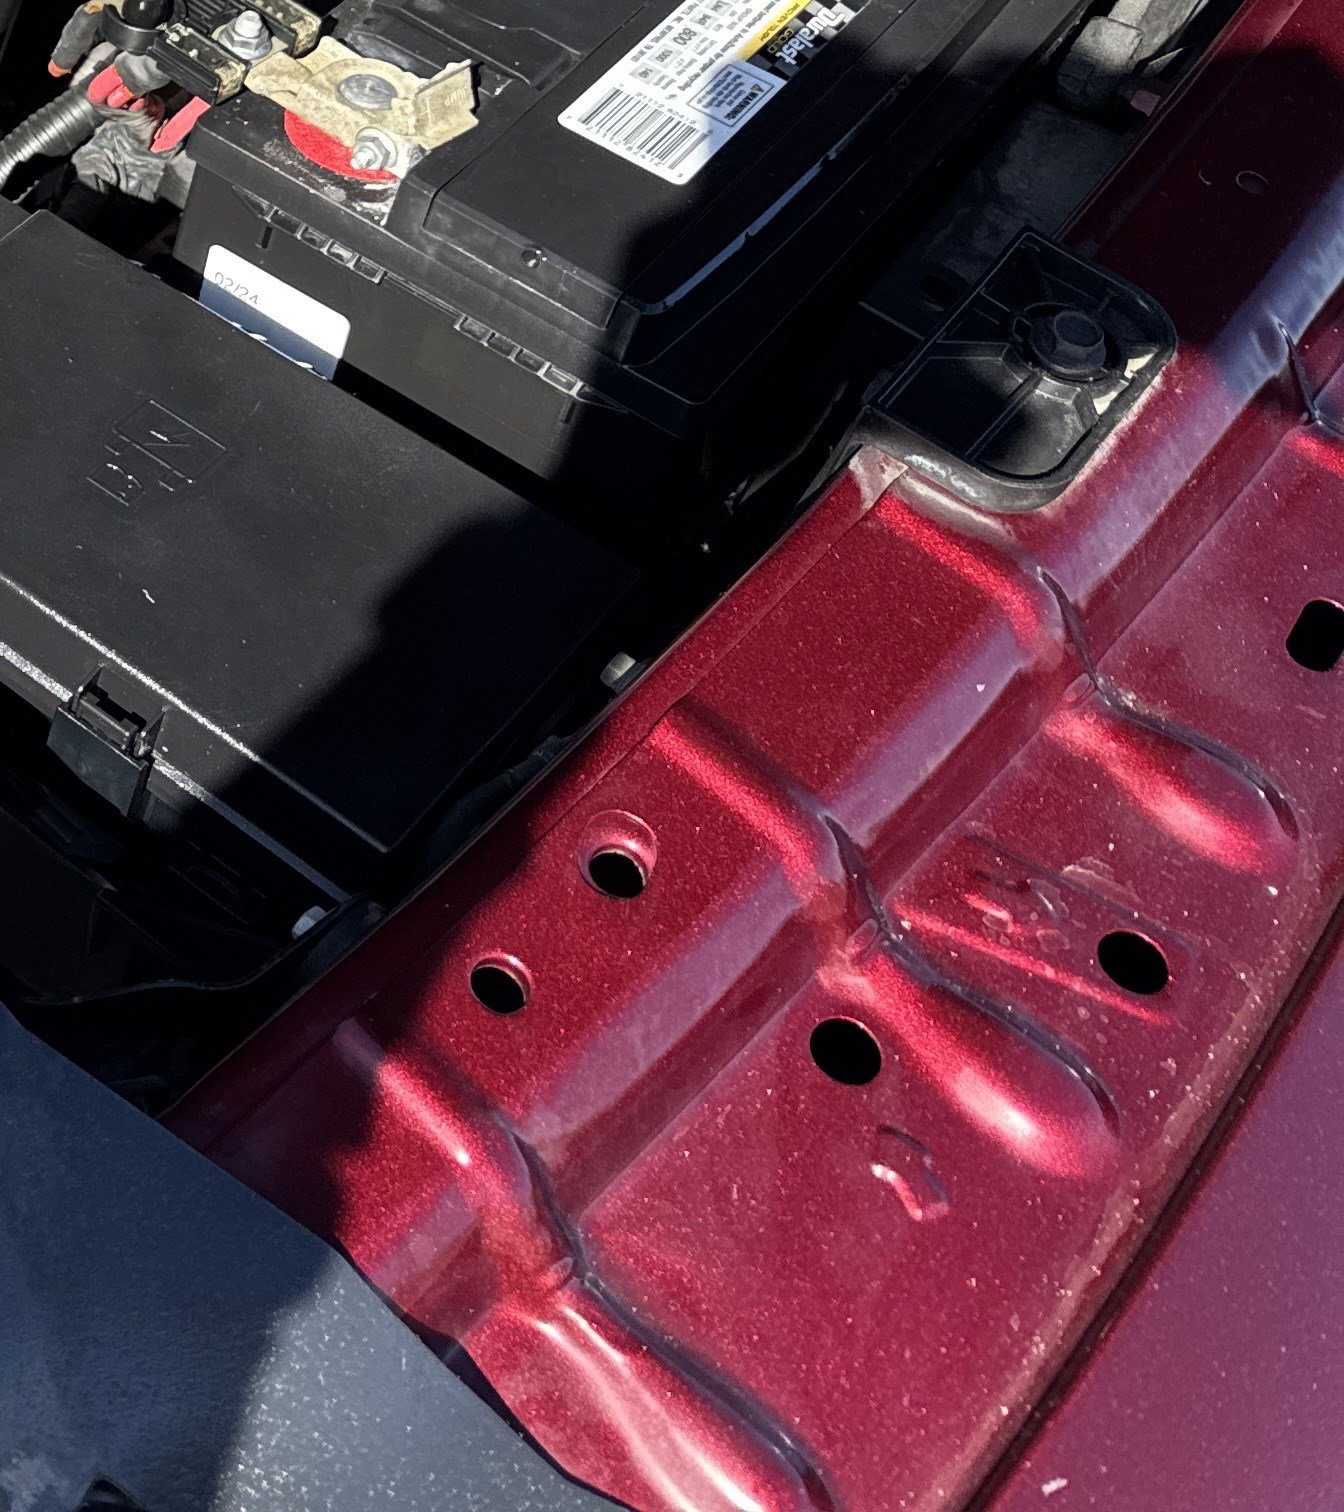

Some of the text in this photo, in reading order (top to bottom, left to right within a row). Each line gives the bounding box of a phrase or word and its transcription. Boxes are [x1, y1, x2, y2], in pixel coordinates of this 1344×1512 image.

[670, 26, 698, 47] 800
[766, 27, 796, 54] GOLD
[775, 7, 846, 66] Duralast
